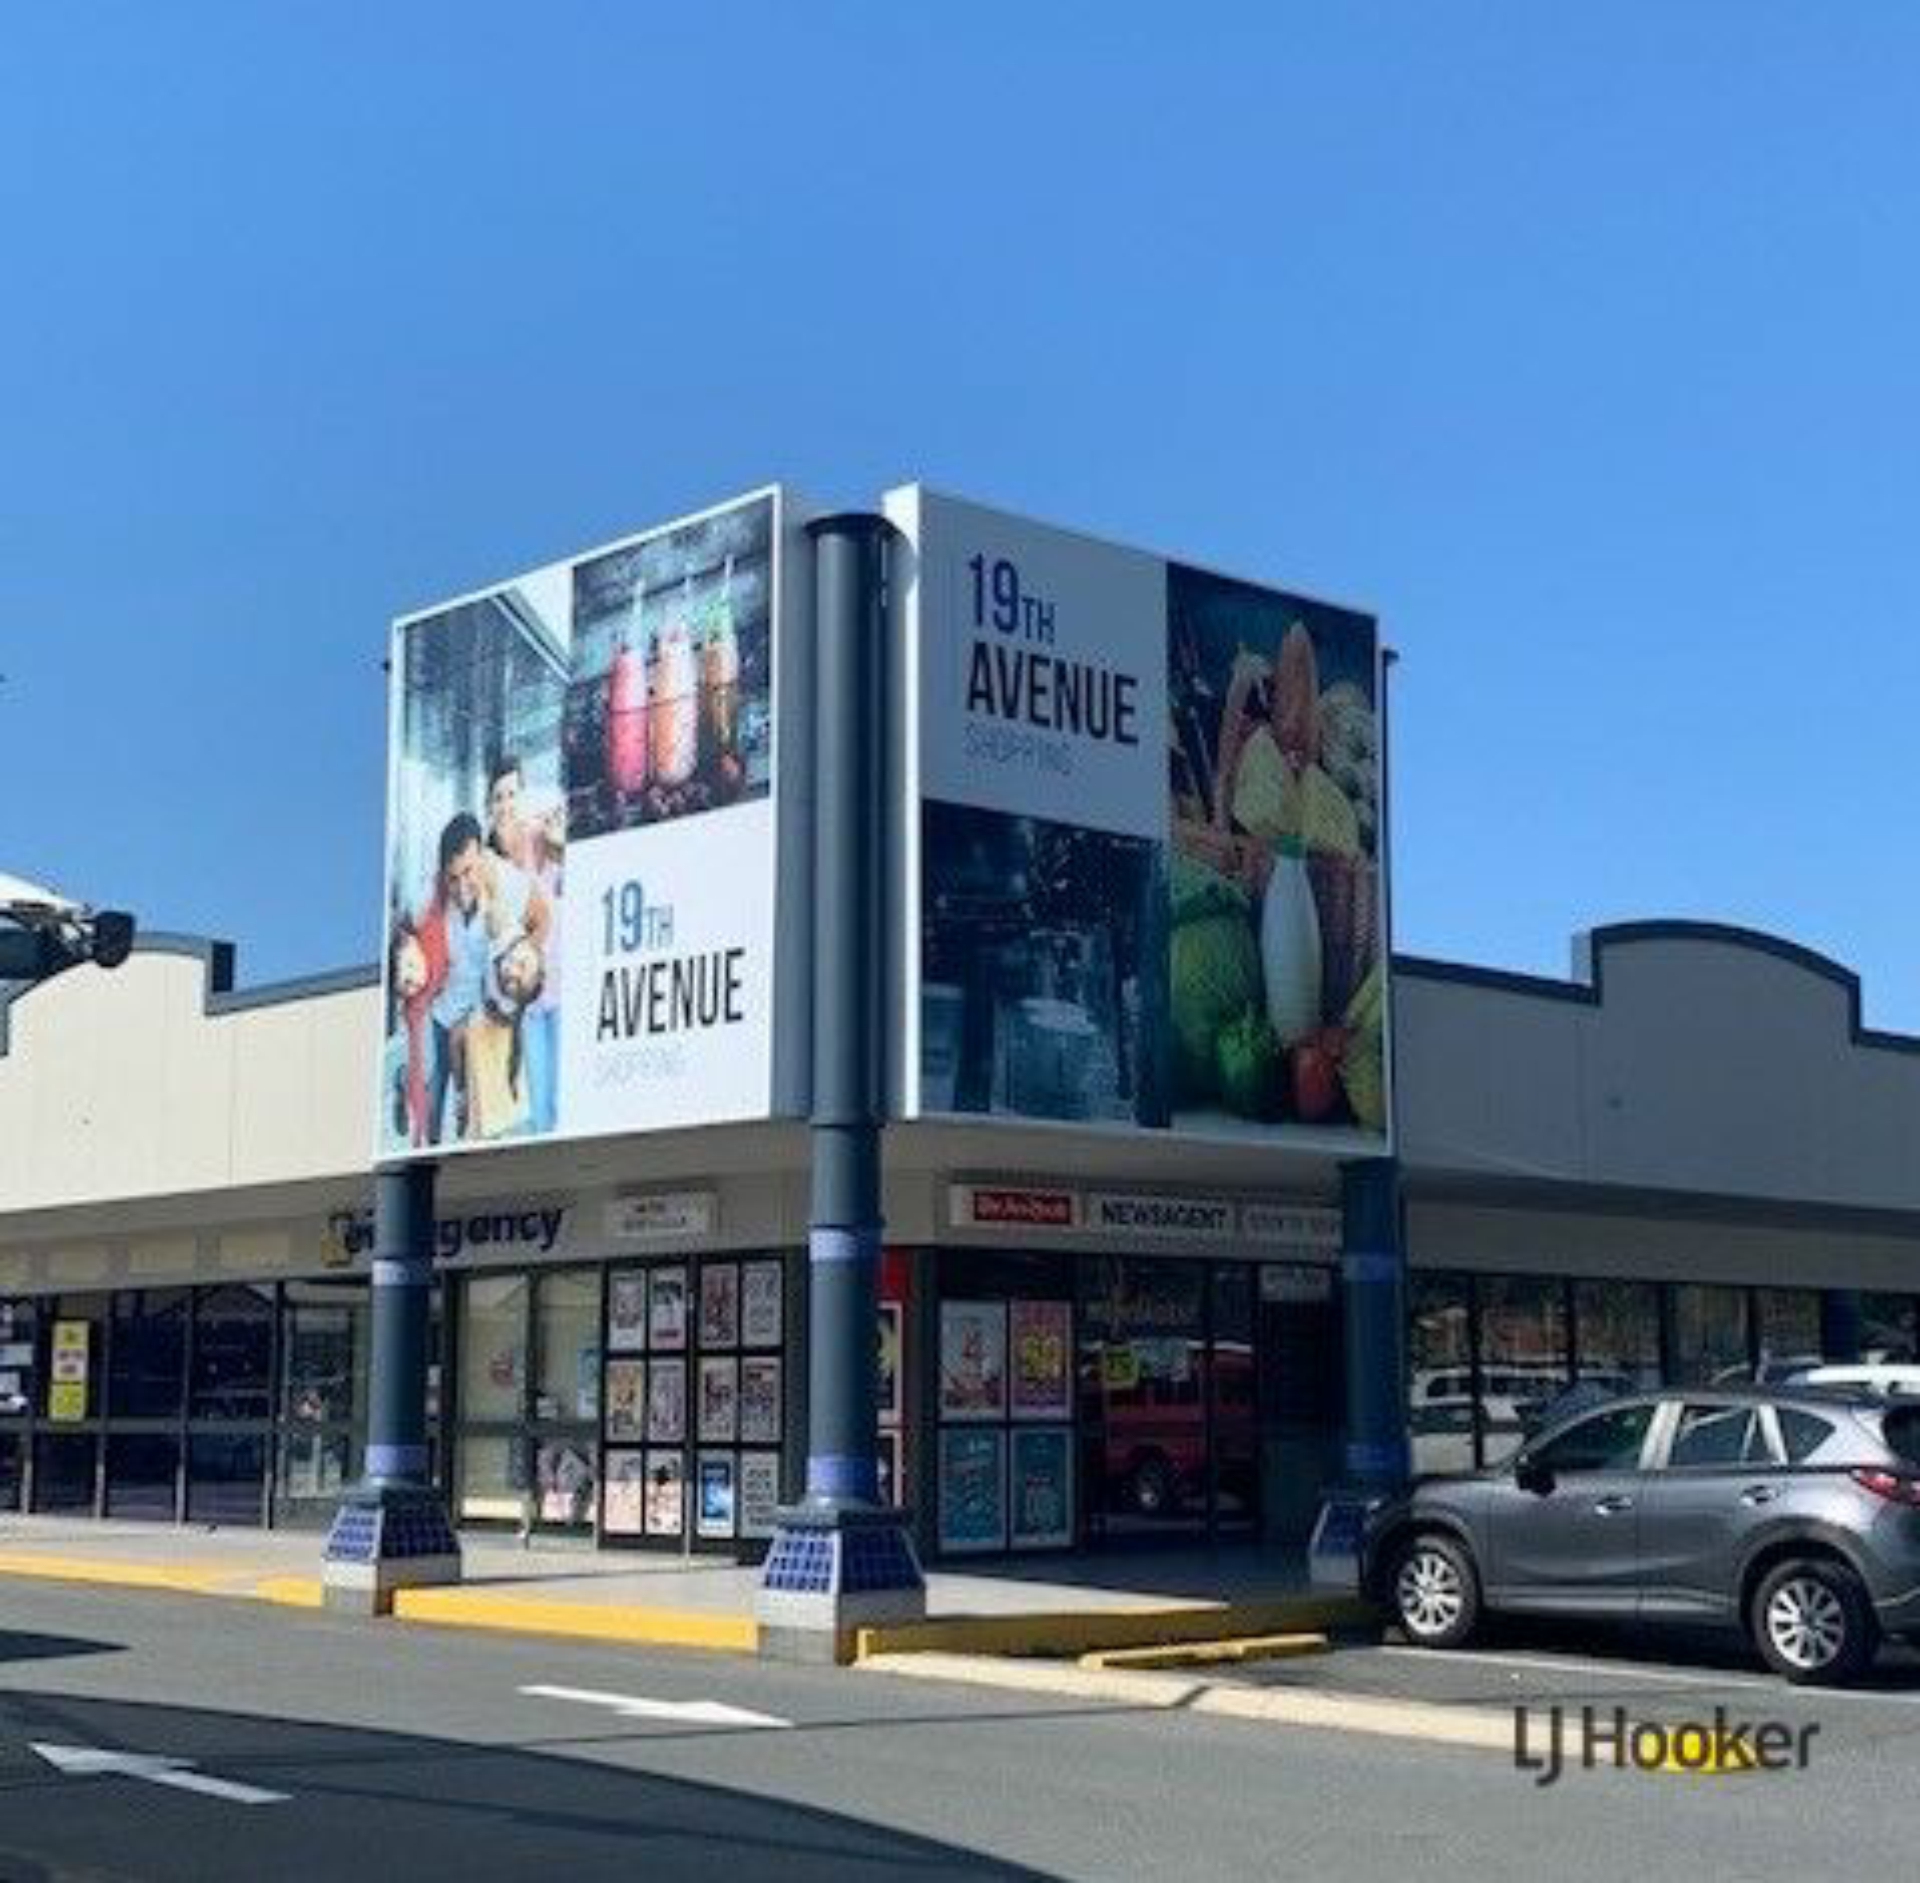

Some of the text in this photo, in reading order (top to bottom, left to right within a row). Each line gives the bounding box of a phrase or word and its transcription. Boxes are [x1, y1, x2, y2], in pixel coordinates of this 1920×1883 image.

[968, 552, 1056, 645] 19TH
[966, 640, 1140, 747] AVENUE
[601, 879, 674, 957] 19TH
[596, 945, 745, 1044] AVENUE
[1101, 1199, 1227, 1231] NEWSAGENT
